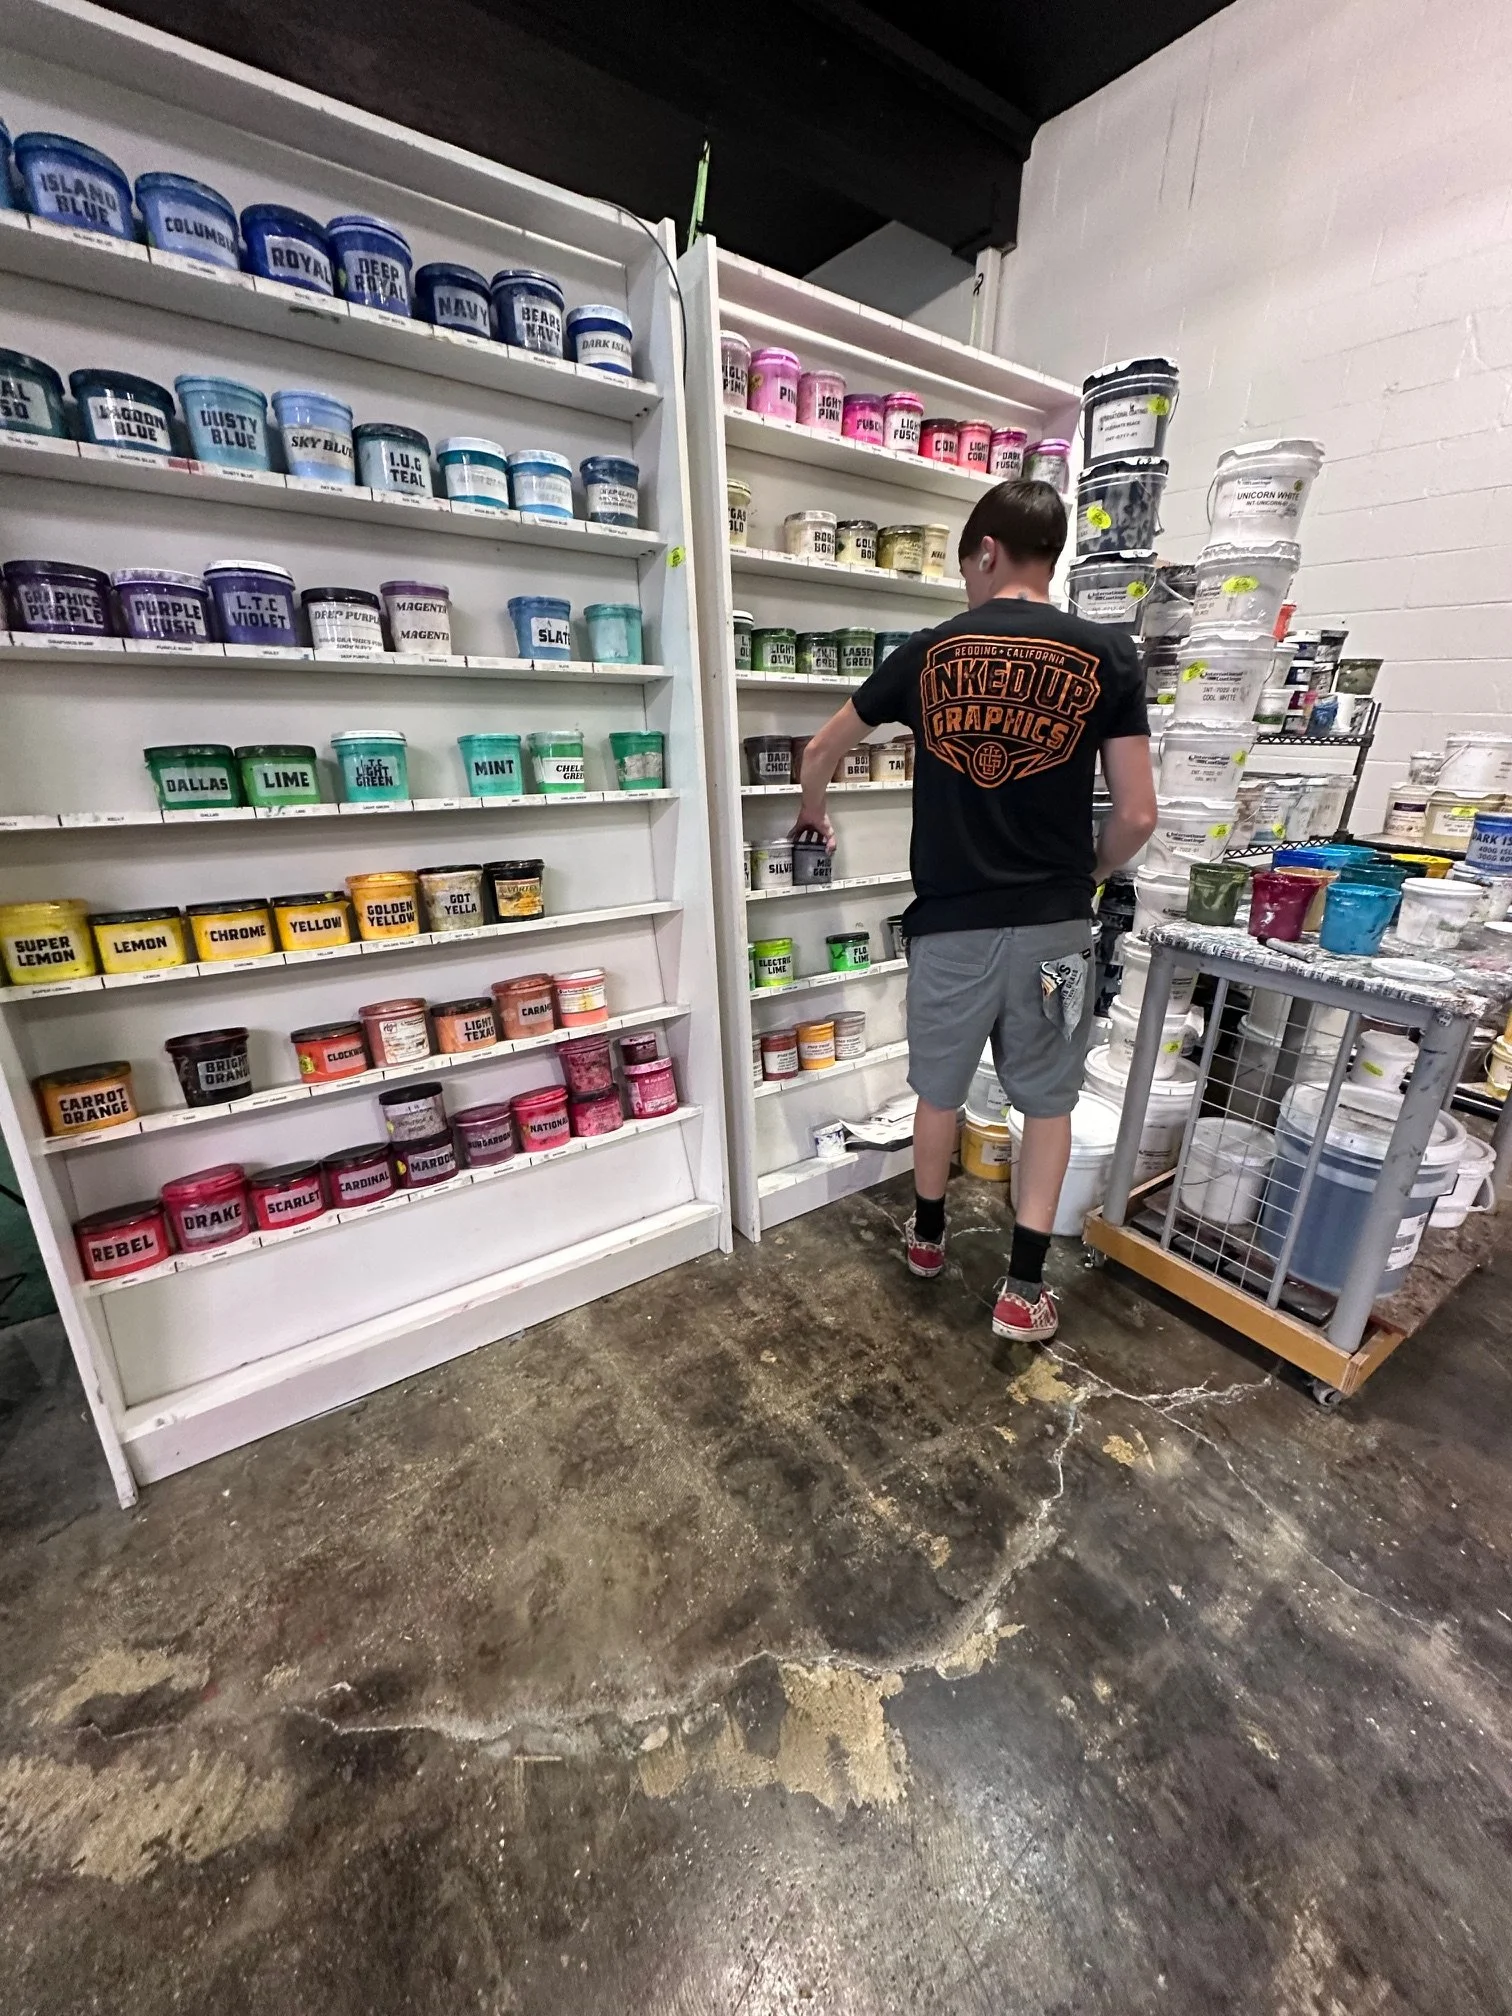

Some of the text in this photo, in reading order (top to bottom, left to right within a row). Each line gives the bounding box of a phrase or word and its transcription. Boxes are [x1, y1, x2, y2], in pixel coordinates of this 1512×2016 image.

[40, 173, 117, 212] ISLAND
[56, 193, 110, 227] BLUE
[272, 246, 333, 287] ROYAL
[358, 256, 400, 281] DEEP
[355, 273, 407, 302] ROYAL
[438, 296, 488, 326] NAVY
[521, 306, 561, 333] BEARS
[525, 321, 560, 347] NAVY
[582, 339, 610, 352] DARK
[723, 378, 746, 397] PINK
[818, 396, 842, 411] IGHT
[98, 405, 166, 430] LAGOON
[201, 409, 259, 434] DUSTY
[818, 408, 841, 422] PINK
[116, 420, 158, 442] BLUE
[212, 427, 257, 451] BLUE
[291, 435, 320, 450] SKY
[390, 451, 422, 472] I.U.G
[1002, 451, 1021, 463] DARK
[389, 468, 426, 489] TEAL
[1236, 491, 1302, 501] UNICORN WHITE
[728, 507, 747, 522] GAS
[25, 590, 100, 609] GRAPHICS
[396, 601, 448, 614] MAGENTA
[29, 604, 104, 625] PURPLE
[136, 600, 202, 620] PURPLE
[314, 610, 343, 621] DEEP
[149, 615, 197, 636] KUSH
[232, 612, 287, 629] VIOLET
[400, 629, 450, 642] MAGENTA
[770, 643, 795, 656] LIGHT
[955, 646, 1066, 666] REDDING CALIFORNIA
[770, 654, 795, 667] OLIVE
[924, 658, 1096, 715] INKED UP
[1202, 694, 1237, 703] COOL WHITE
[932, 704, 1071, 750] GRAPHICS
[766, 752, 790, 764] DARK
[356, 765, 390, 778] LIGHT
[474, 759, 515, 777] MINT
[166, 776, 229, 793] DALLAS
[264, 771, 309, 789] LIME
[355, 776, 394, 788] GREEN
[450, 893, 471, 904] GOT
[366, 900, 413, 916] GOLDEN
[444, 902, 478, 916] YELLA
[290, 916, 342, 933] YELLOW
[367, 911, 415, 927] YELLOW
[210, 925, 267, 942] CHROME
[15, 936, 71, 953] SUPER
[114, 936, 168, 954] LEMON
[17, 949, 76, 967] LEMON
[767, 965, 788, 976] LIME
[465, 1016, 492, 1031] LIGHT
[465, 1027, 496, 1042] TEXAS
[59, 1087, 125, 1112] CARROT
[62, 1100, 129, 1125] ORANGE
[530, 1117, 570, 1133] NATIONAL
[339, 1170, 390, 1193] CARDINAL
[267, 1190, 320, 1214] SCARLET
[184, 1202, 242, 1230] DRAKE
[93, 1234, 154, 1262] REBEL
